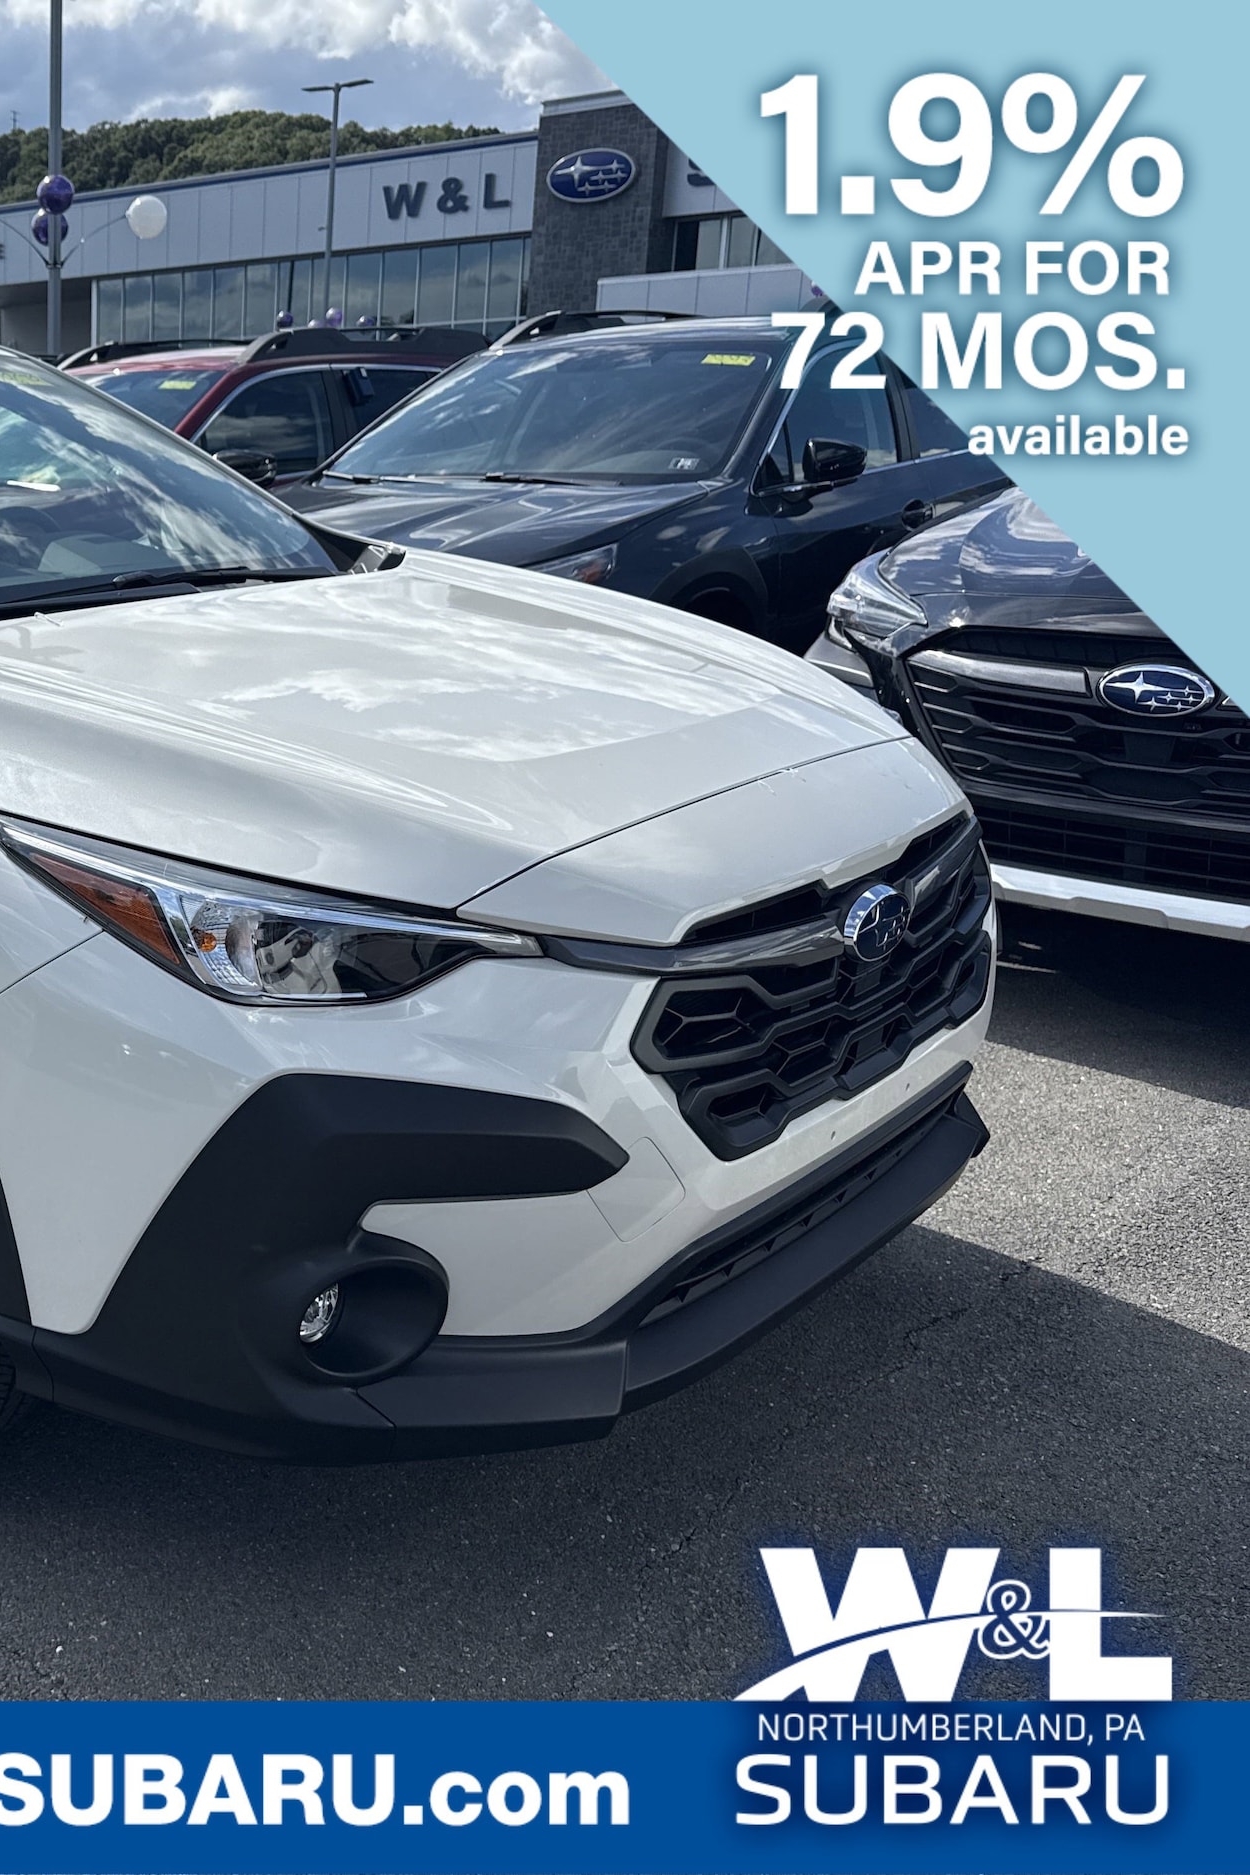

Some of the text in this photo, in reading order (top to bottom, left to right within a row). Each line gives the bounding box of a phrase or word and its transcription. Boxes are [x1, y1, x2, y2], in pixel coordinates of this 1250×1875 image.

[383, 172, 511, 220] W & L
